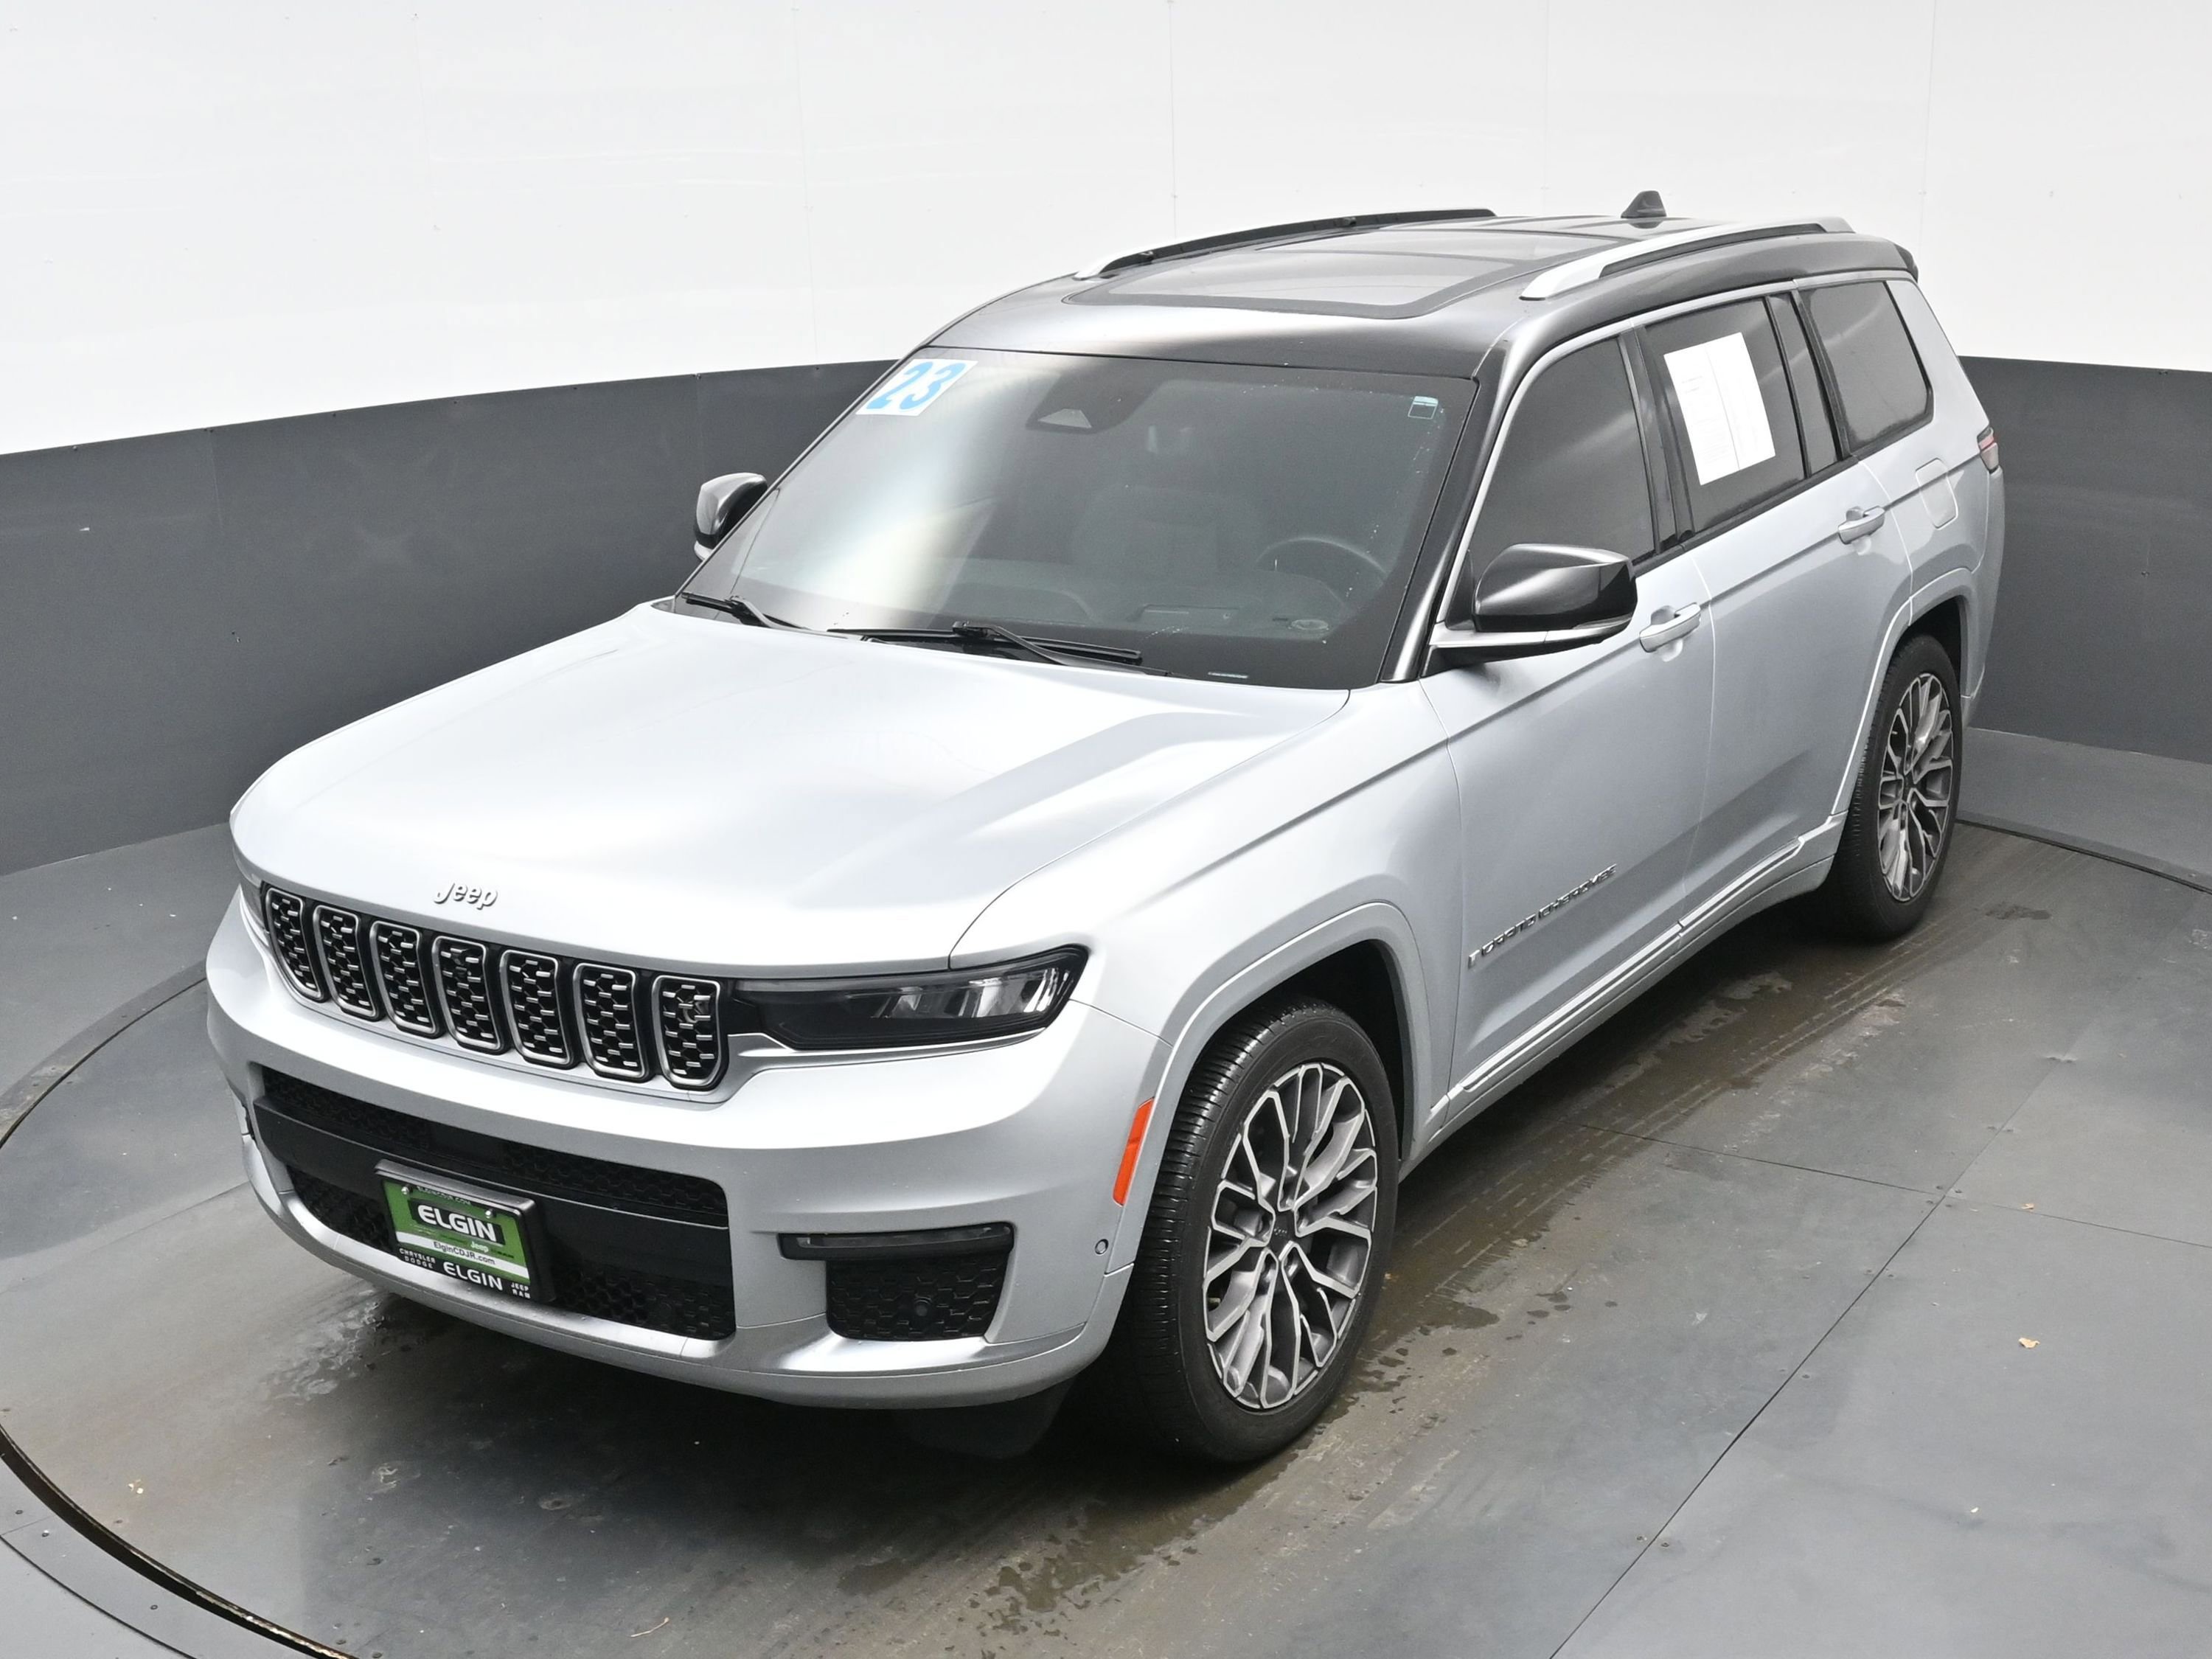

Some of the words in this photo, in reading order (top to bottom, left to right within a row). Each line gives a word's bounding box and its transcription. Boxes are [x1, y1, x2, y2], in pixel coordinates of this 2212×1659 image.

[865, 361, 967, 411] 23
[433, 882, 498, 911] Jeep
[417, 1204, 497, 1242] ELGIN
[399, 1248, 437, 1264] CHRYSLER
[404, 1256, 434, 1269] DODGE
[433, 1241, 495, 1265] ElginCDJR.com
[443, 1261, 504, 1291] ELGIN
